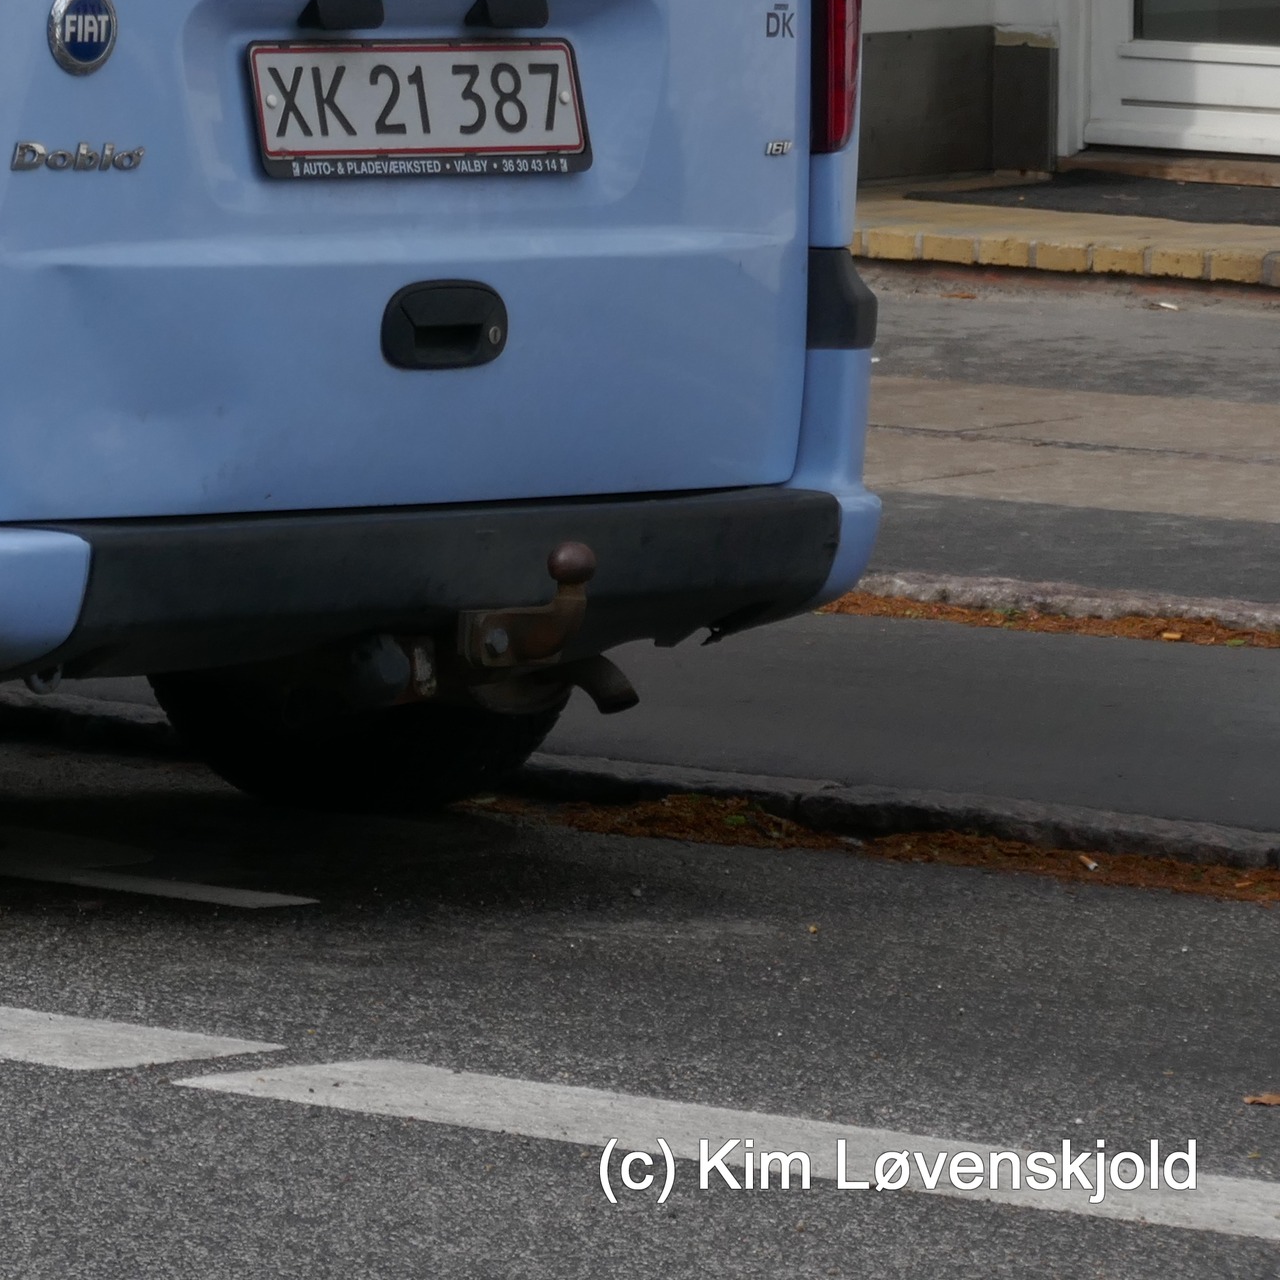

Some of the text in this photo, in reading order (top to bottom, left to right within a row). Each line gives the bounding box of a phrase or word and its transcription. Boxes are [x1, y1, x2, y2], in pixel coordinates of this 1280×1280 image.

[65, 14, 109, 42] FIAT
[766, 11, 794, 38] DK
[267, 62, 559, 137] XK 21 387
[766, 141, 792, 155] 16V
[303, 159, 557, 175] AUTO- & PLADEVÆRKSTED VALBY 36 30 43 14
